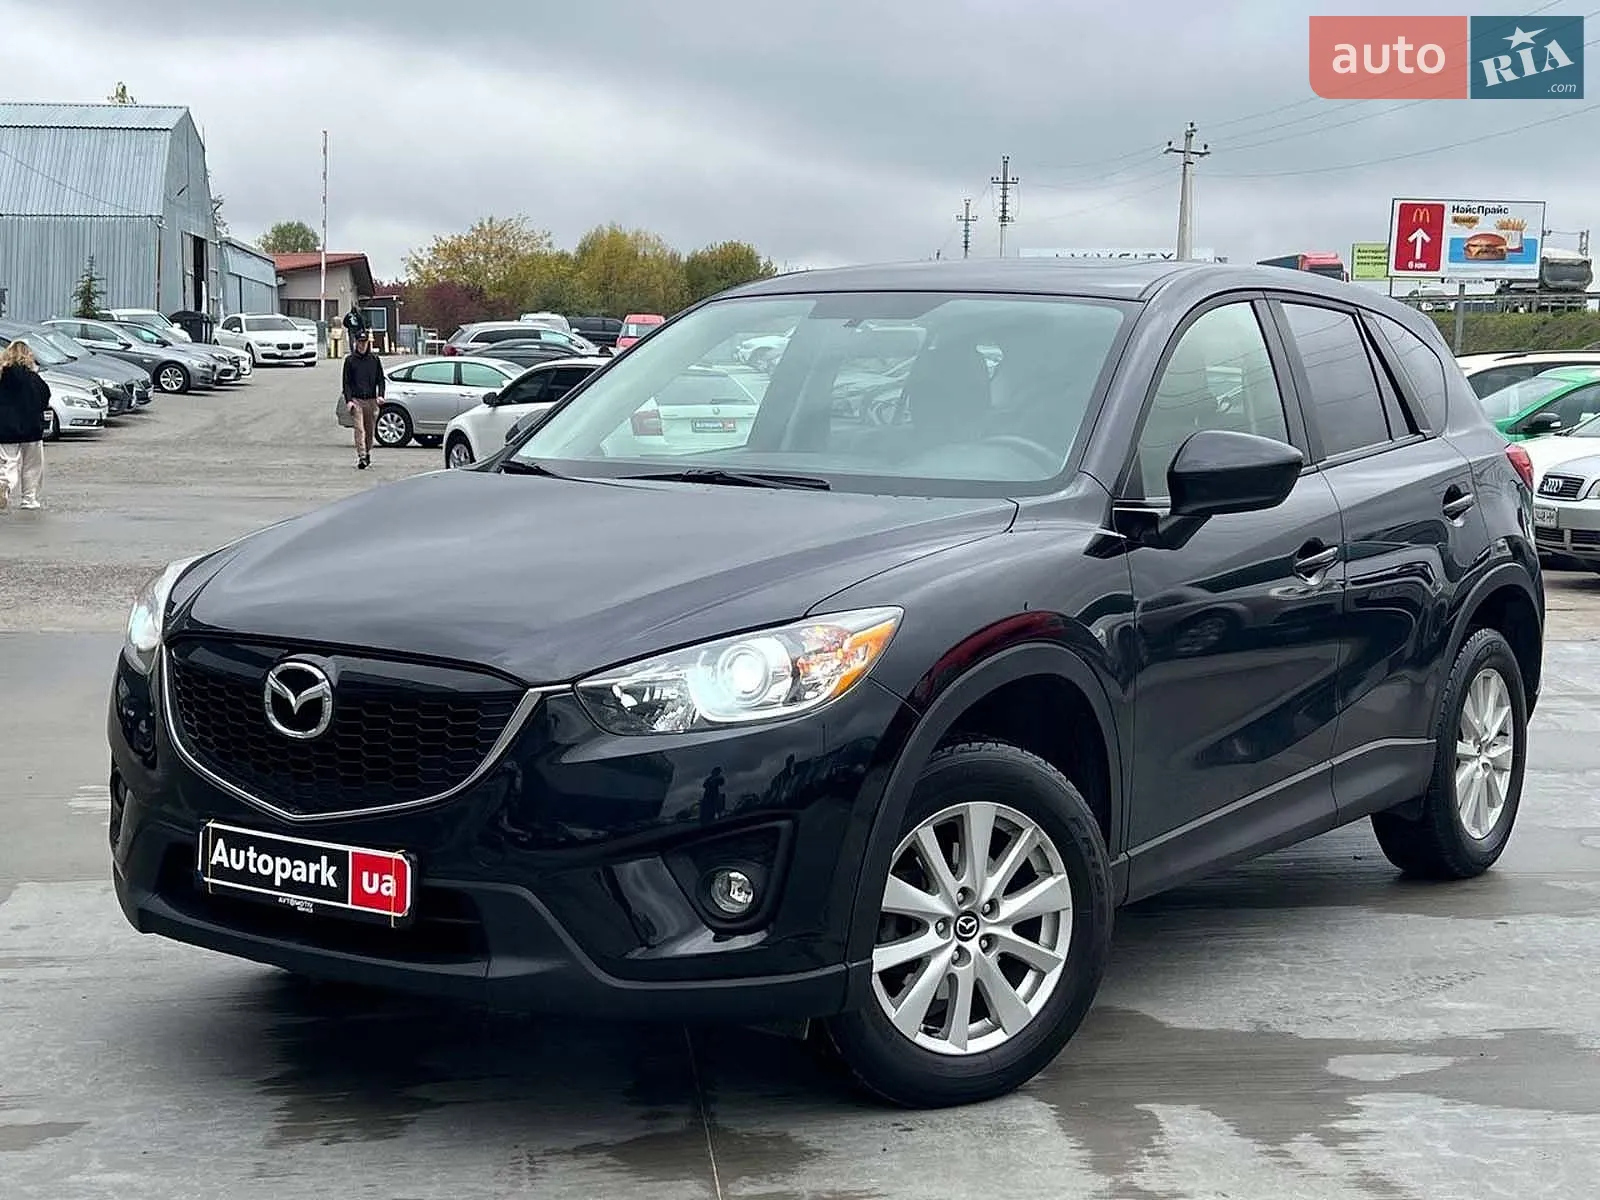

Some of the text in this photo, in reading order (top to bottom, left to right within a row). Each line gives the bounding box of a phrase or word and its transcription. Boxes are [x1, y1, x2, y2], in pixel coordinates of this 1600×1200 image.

[1451, 204, 1509, 216] НайсПрайс
[210, 838, 397, 897] Autopark ua
